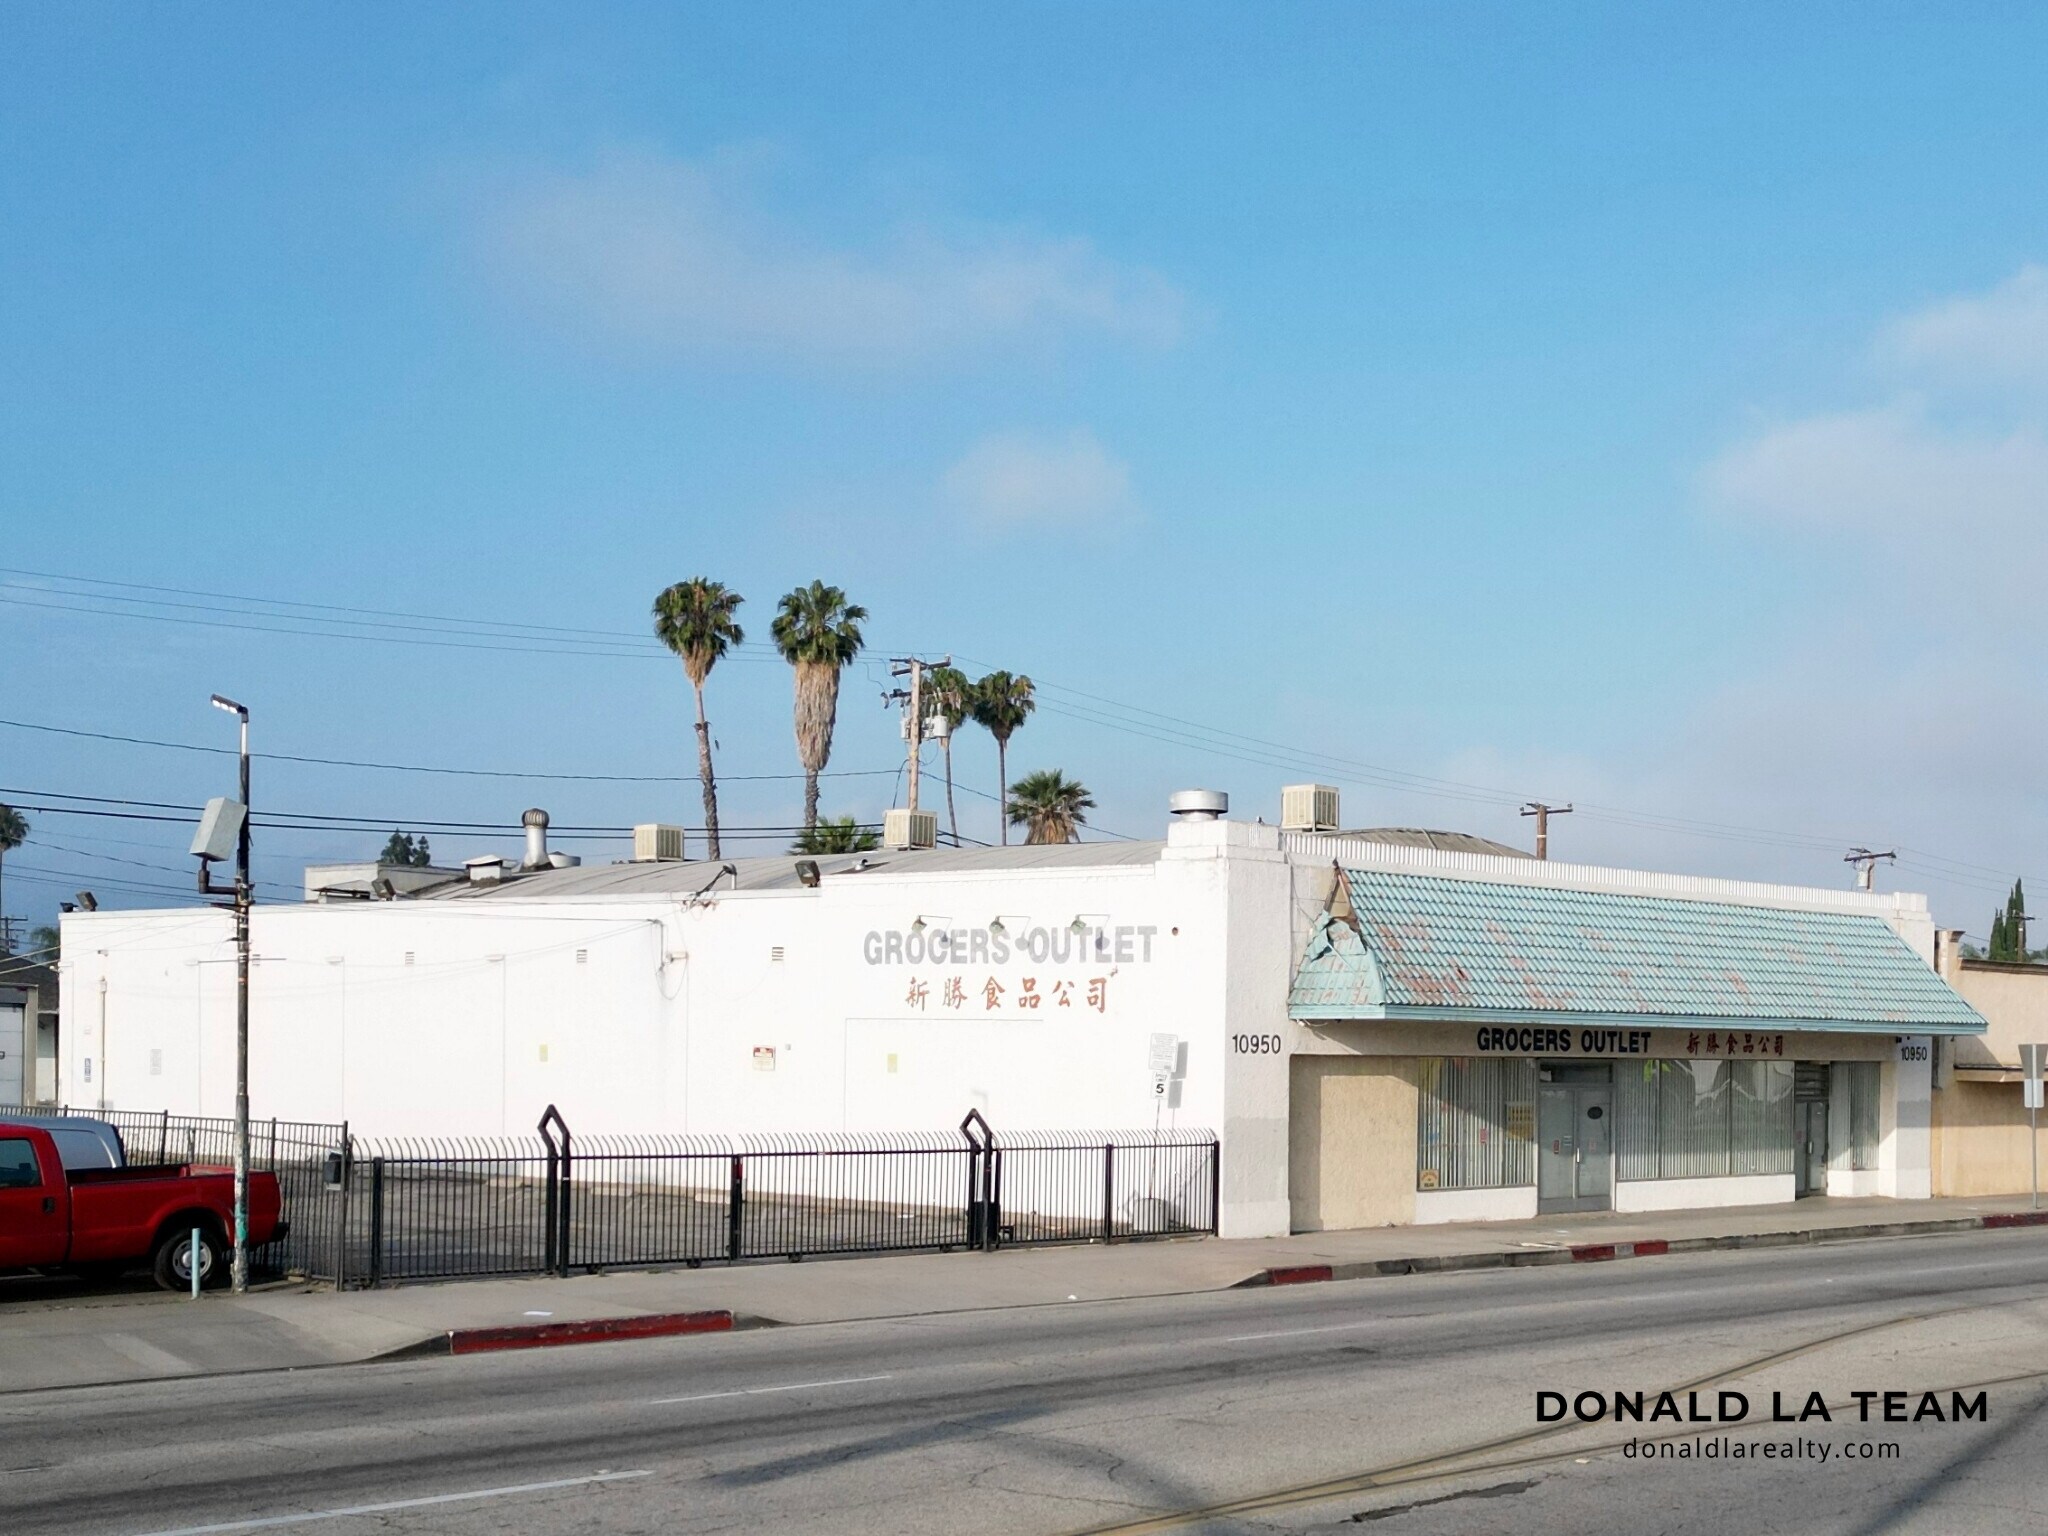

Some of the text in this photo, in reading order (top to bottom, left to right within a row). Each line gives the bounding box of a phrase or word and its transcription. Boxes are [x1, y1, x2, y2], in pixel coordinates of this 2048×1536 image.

[864, 926, 1158, 965] GROCERS OUTLET
[905, 976, 1108, 1013] 新勝食品公司
[1232, 1034, 1281, 1054] 10950
[1477, 1027, 1651, 1053] GROCERS OUTLET
[1686, 1032, 1784, 1056] 新勝食品公司
[1901, 1046, 1928, 1061] 10950
[1156, 1083, 1165, 1094] 5
